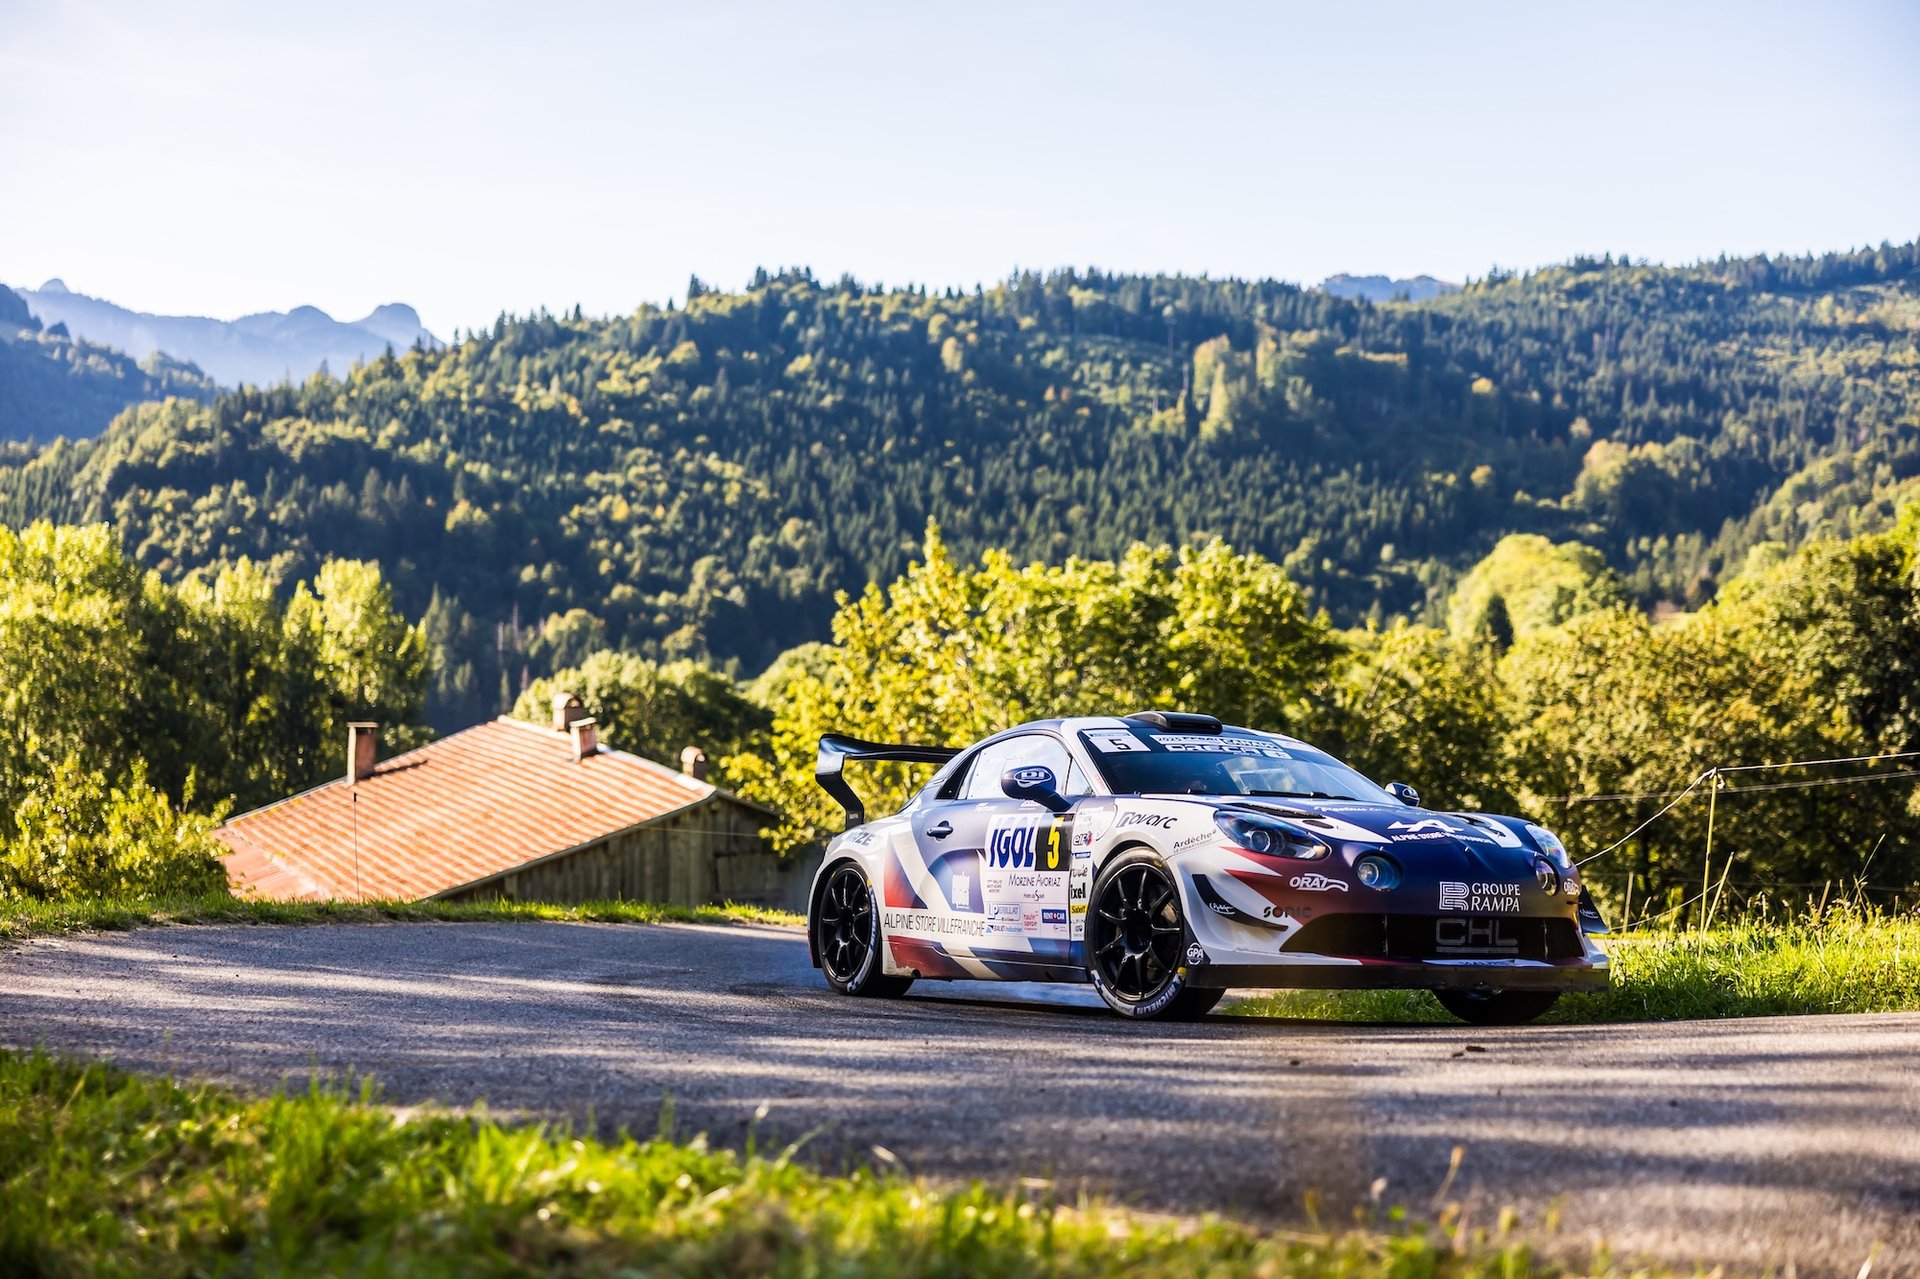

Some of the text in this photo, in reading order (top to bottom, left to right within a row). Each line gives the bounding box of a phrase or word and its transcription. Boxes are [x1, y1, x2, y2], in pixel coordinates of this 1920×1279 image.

[1108, 738, 1131, 750] 5
[989, 817, 1065, 869] IGOL 5
[1173, 832, 1212, 849] Ardèche
[1008, 874, 1035, 887] MORZINE
[1035, 874, 1061, 887] AVORIAZ
[1472, 882, 1521, 896] GROUPE
[1471, 896, 1520, 912] RAMPA
[884, 913, 985, 937] ALPINE STORE VILLEFRANCHE
[1436, 918, 1518, 946] CHL
[1187, 948, 1204, 958] GPA
[1136, 983, 1176, 1015] MICHELIN
